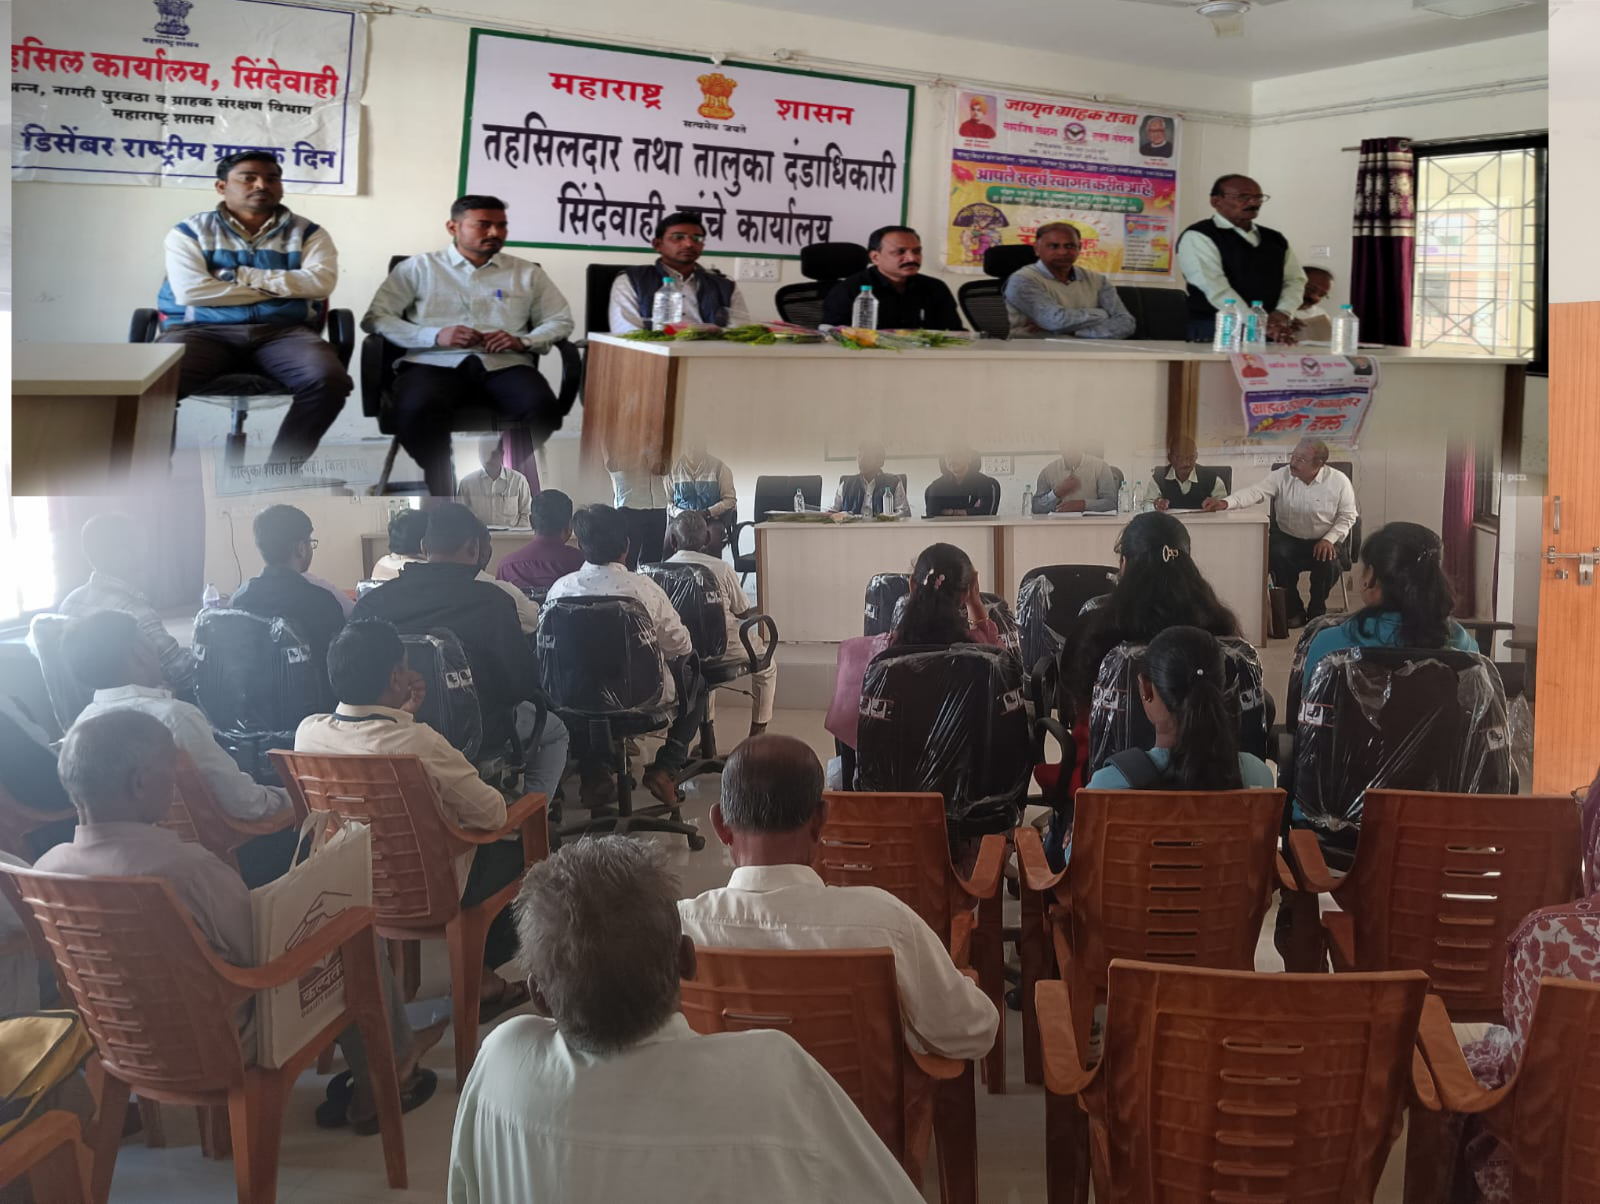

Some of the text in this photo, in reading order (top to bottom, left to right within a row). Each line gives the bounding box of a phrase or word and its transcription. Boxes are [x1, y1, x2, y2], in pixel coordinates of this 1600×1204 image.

[90, 48, 220, 92] कार्यालय,
[231, 55, 339, 99] सिंदेवाही
[52, 85, 97, 98] नागरी
[102, 88, 149, 104] पुरवठा
[155, 93, 166, 104] व
[171, 95, 214, 109] ग्राहक
[217, 96, 262, 111] संरक्षण
[268, 99, 312, 115] विभाग
[112, 107, 215, 126] महाराष्ट्र शासन
[548, 72, 855, 126] महाराष्ट्र शासन
[1004, 99, 1139, 125] जागृत ग्राहक राजा
[22, 124, 337, 169] डिसेंबर राष्ट्रीय ग्राक दिन
[683, 120, 747, 134] सत्यमेव जयते
[482, 111, 623, 173] तहसिलदार
[633, 136, 683, 176] तथा
[693, 143, 775, 197] तालुका
[783, 137, 896, 194] दंडाधिकारी
[976, 165, 1016, 183] आपले
[1049, 174, 1091, 190] स्वागत
[1092, 175, 1127, 193] करीत
[557, 181, 666, 244] सिंदेवाही
[736, 197, 833, 247] कार्यालय
[301, 961, 344, 1002] कल्पत
